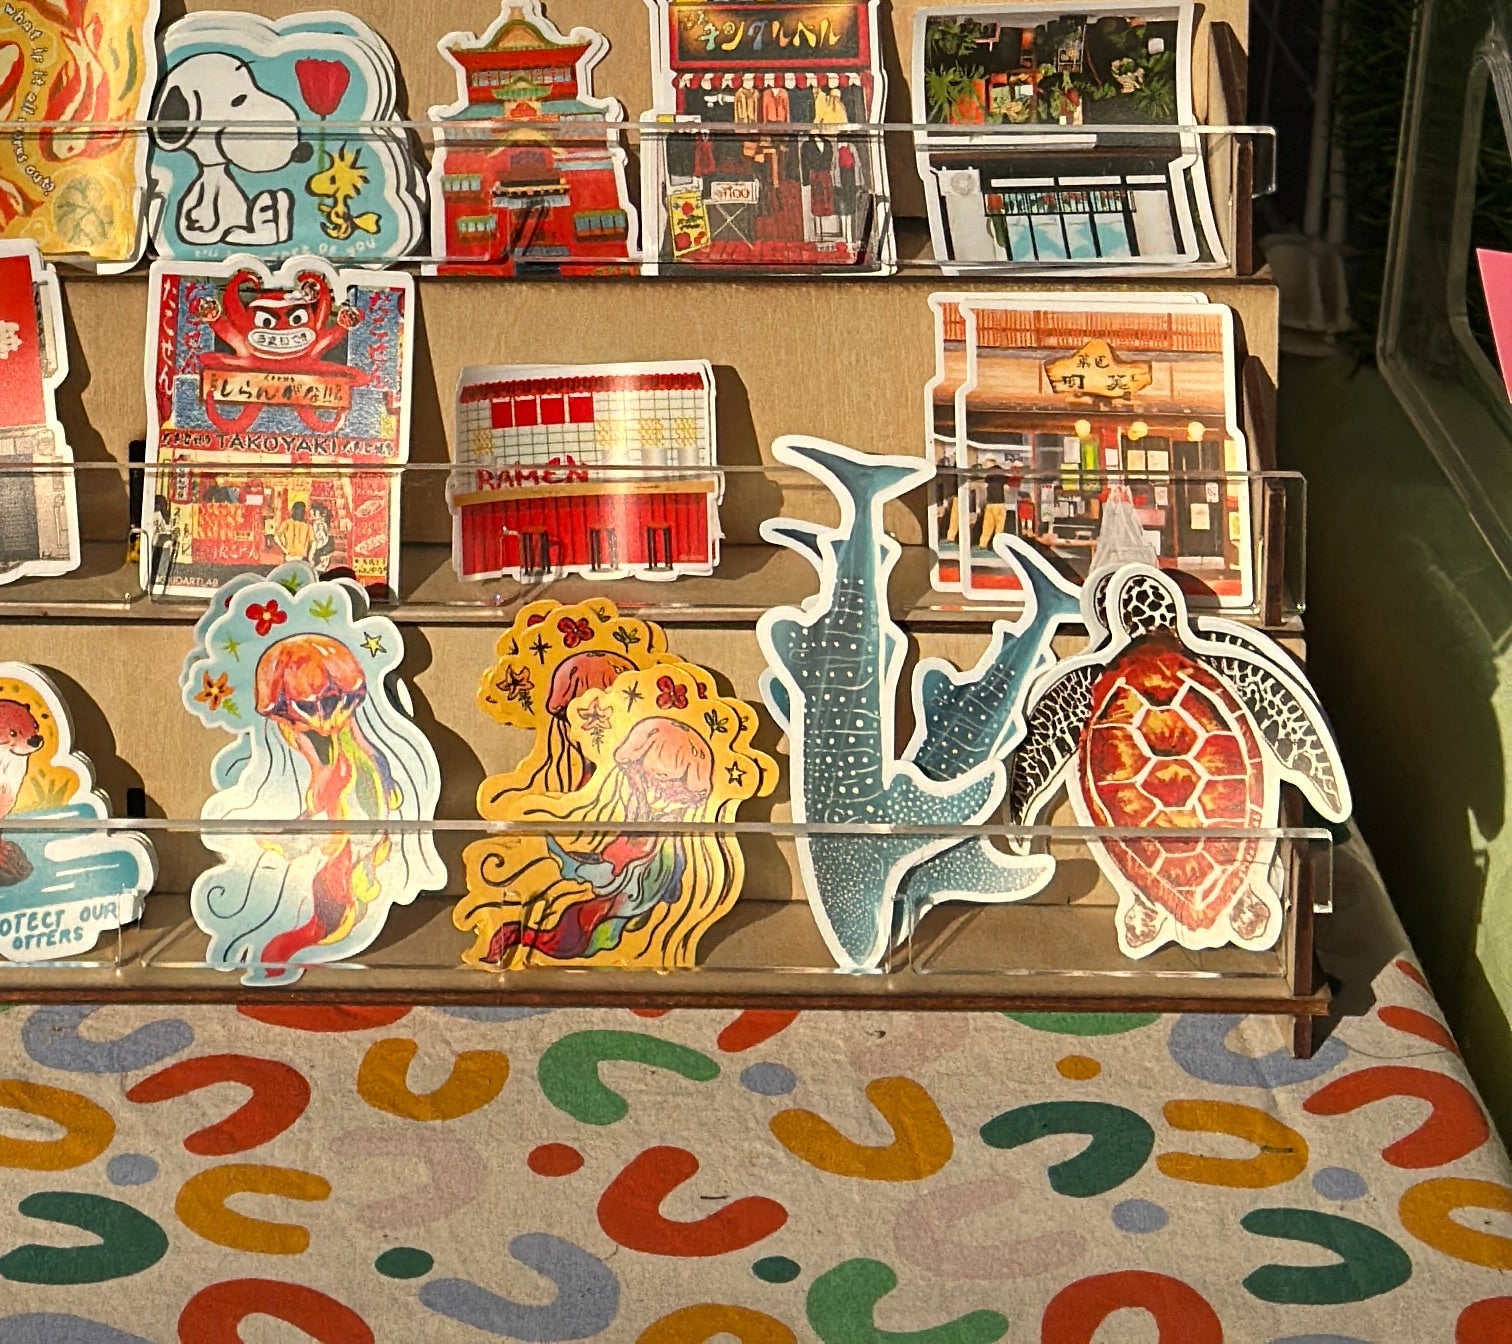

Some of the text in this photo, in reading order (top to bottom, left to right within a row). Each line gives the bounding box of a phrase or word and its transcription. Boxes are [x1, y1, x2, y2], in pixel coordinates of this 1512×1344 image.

[216, 433, 337, 454] TAKOYAKI
[80, 901, 118, 922] OUR
[12, 926, 84, 952] OTTERS
